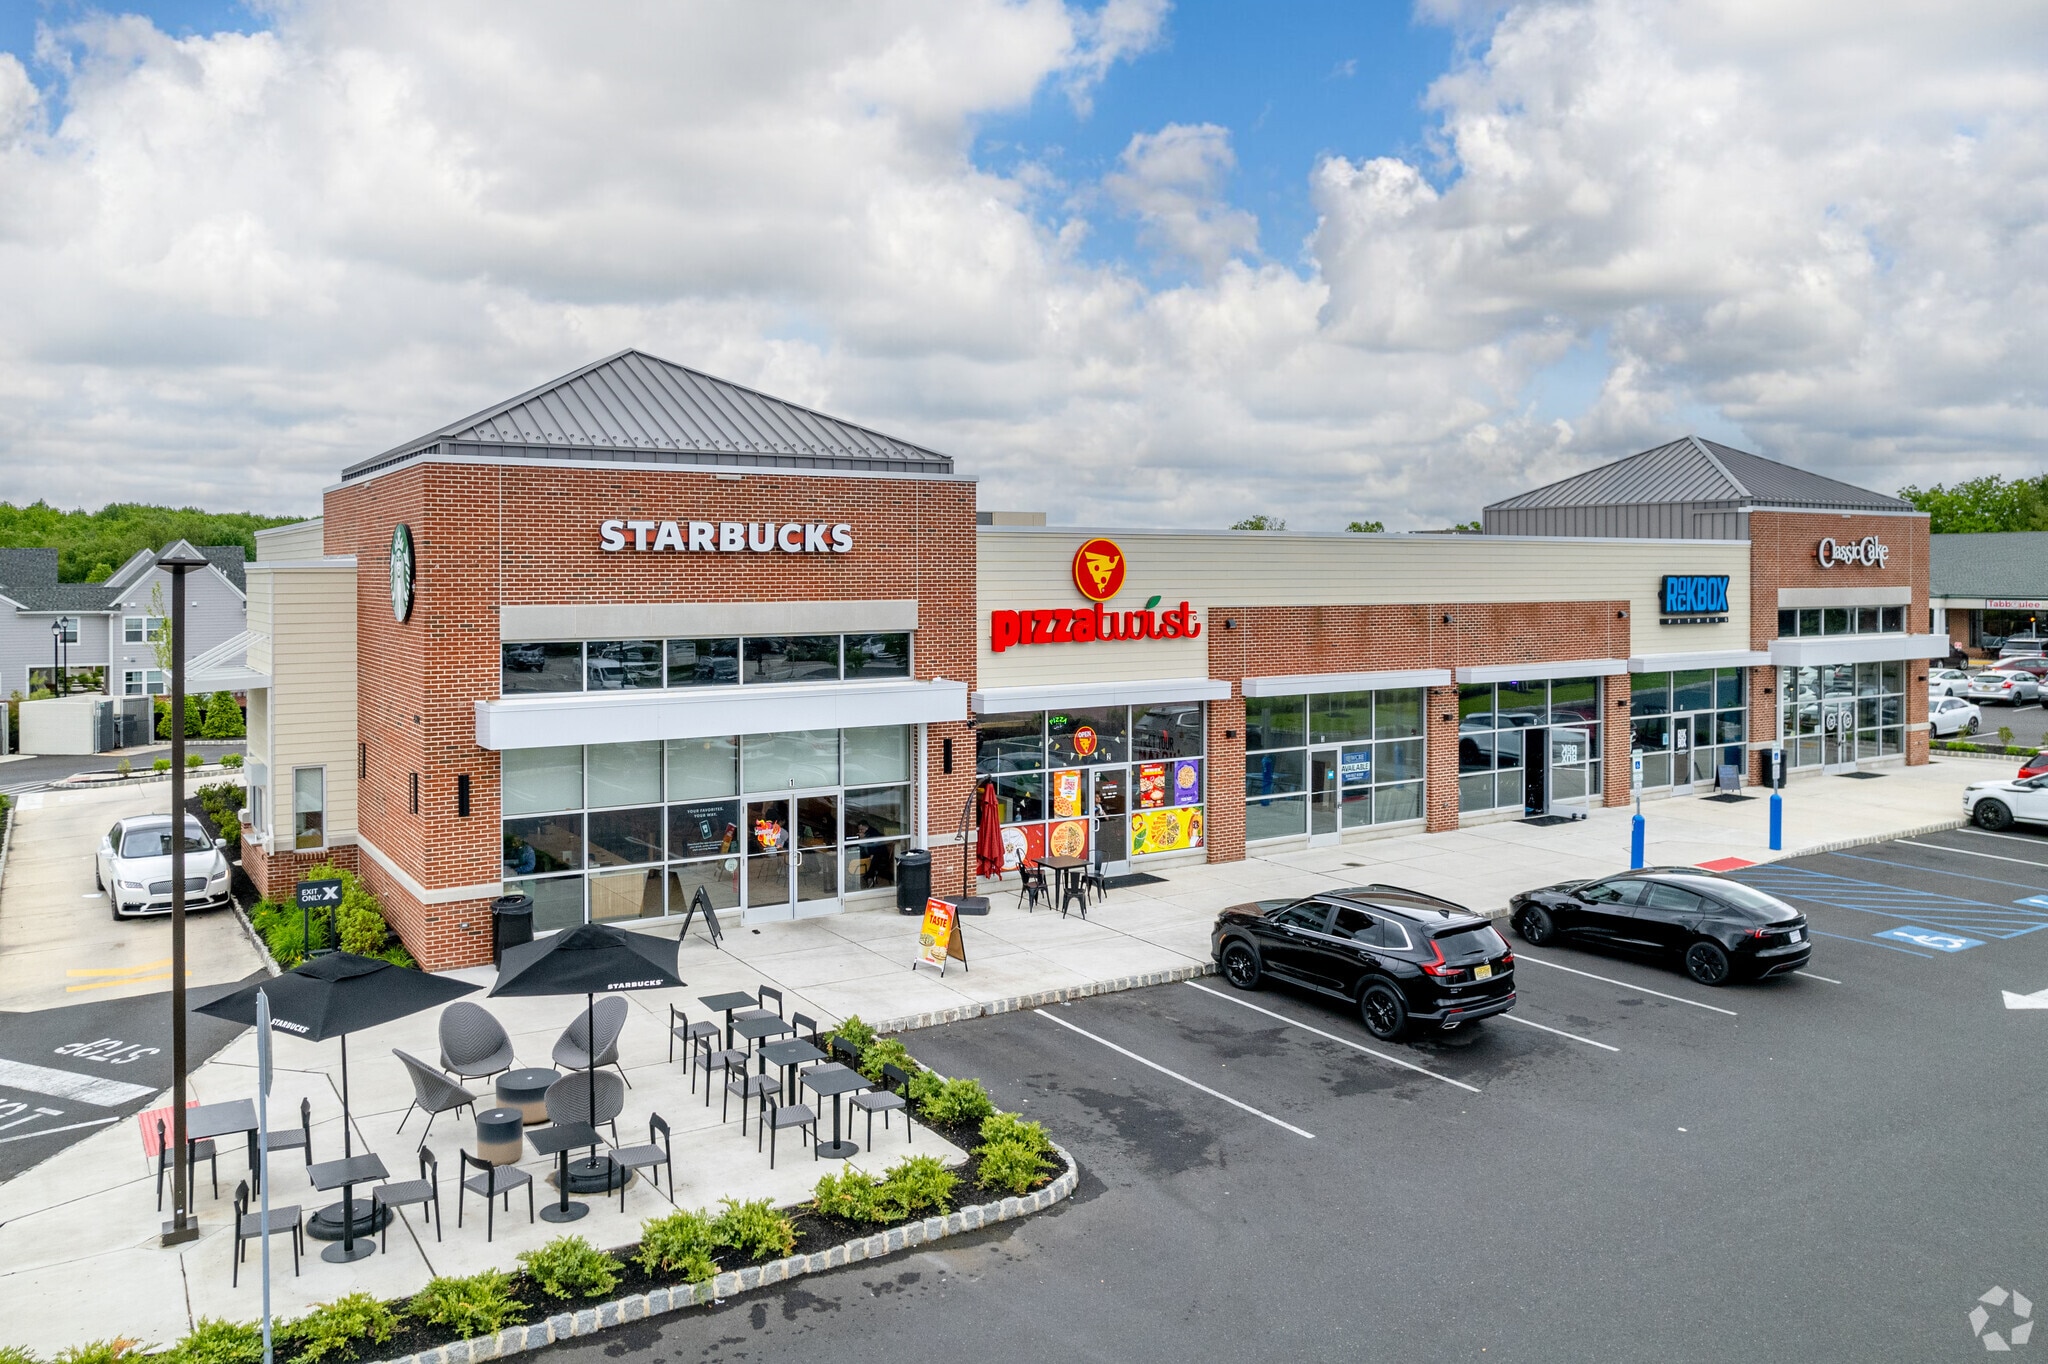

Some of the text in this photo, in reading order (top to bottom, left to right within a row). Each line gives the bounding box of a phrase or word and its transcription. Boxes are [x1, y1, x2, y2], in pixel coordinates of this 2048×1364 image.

[600, 520, 853, 552] STARBUCKS
[1667, 577, 1729, 611] ROCKBOX
[1341, 763, 1369, 772] AVAILABLE
[301, 894, 322, 902] ONLY
[929, 915, 948, 928] TASTE
[607, 979, 663, 990] STARBUCKS
[271, 1018, 309, 1034] STARBUCKS
[54, 1037, 160, 1065] STOP
